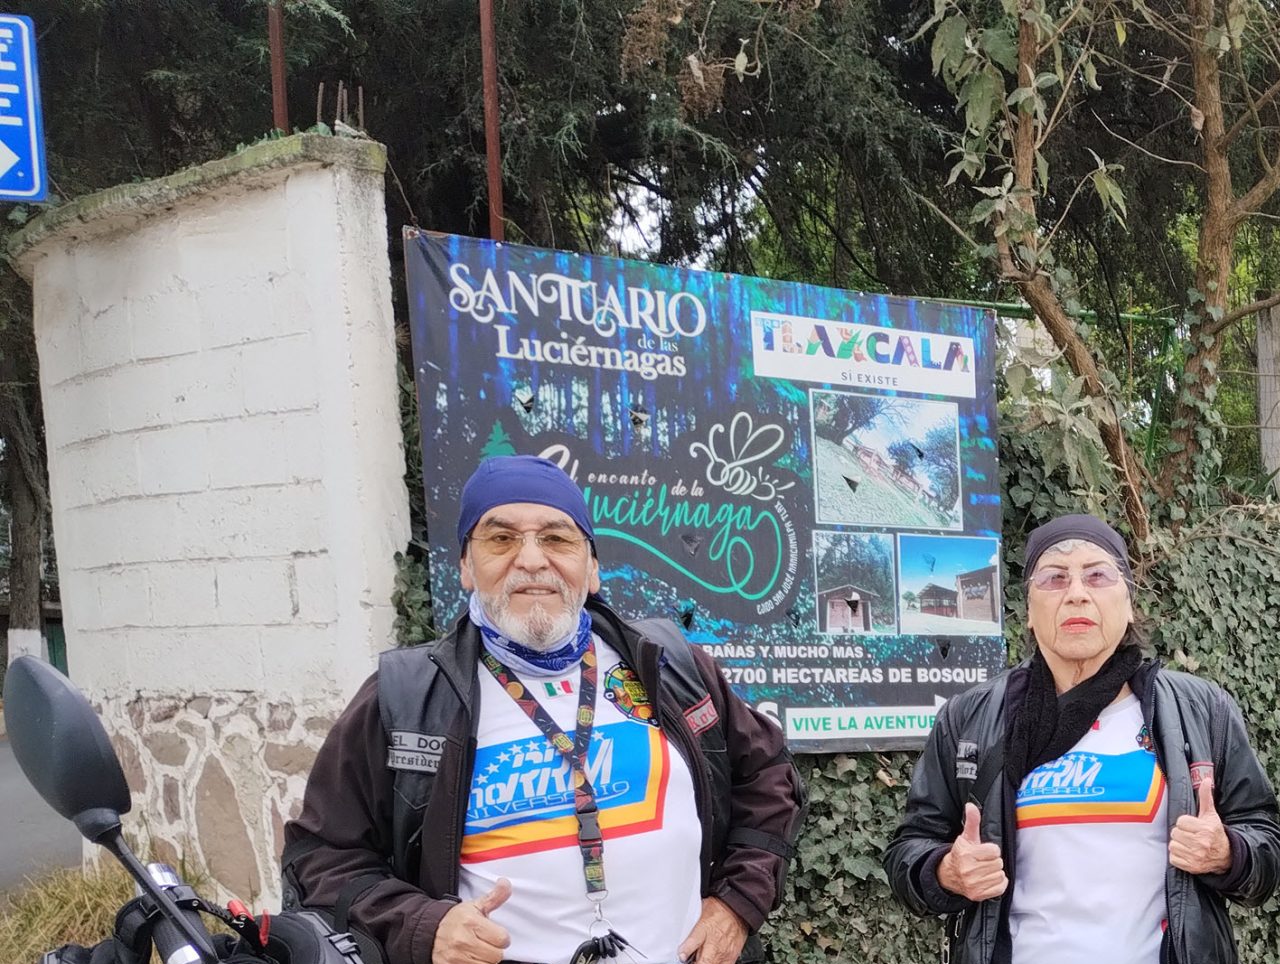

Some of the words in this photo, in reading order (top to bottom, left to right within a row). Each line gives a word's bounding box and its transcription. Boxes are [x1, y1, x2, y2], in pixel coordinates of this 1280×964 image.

[449, 262, 706, 338] SANTUARIO
[493, 324, 687, 380] Luciérnagas
[637, 336, 656, 351] de
[659, 336, 679, 352] las
[754, 316, 970, 373] TLAXCALA
[857, 372, 899, 387] EXISTE
[588, 469, 658, 486] encanto
[671, 478, 687, 496] de
[690, 480, 704, 497] la
[759, 645, 770, 659] Y
[774, 645, 829, 659] MUCHO
[720, 667, 767, 684] 2700
[772, 667, 884, 684] HECTAREAS
[888, 667, 912, 683] DE
[917, 667, 988, 684] BOSQUE
[792, 716, 831, 732] VIVE
[837, 716, 858, 731] LA
[393, 735, 408, 747] EL
